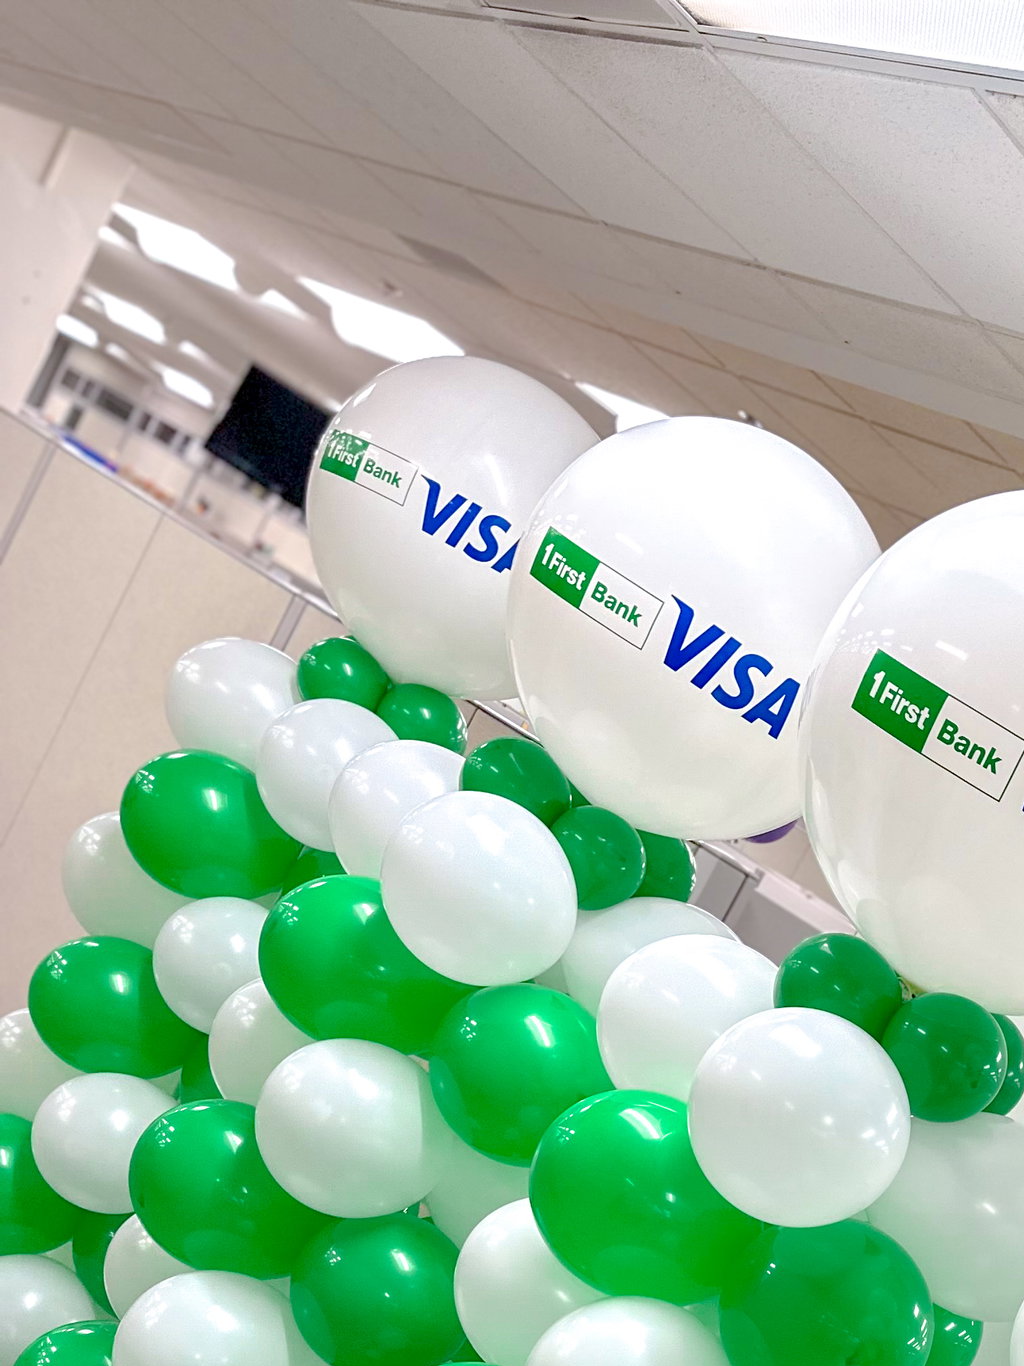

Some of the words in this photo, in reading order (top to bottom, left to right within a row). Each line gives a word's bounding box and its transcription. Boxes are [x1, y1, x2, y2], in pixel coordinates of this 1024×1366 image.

[363, 458, 402, 489] Bank
[590, 581, 642, 627] Bank
[663, 594, 800, 739] VISA
[936, 718, 1003, 775] Bank
